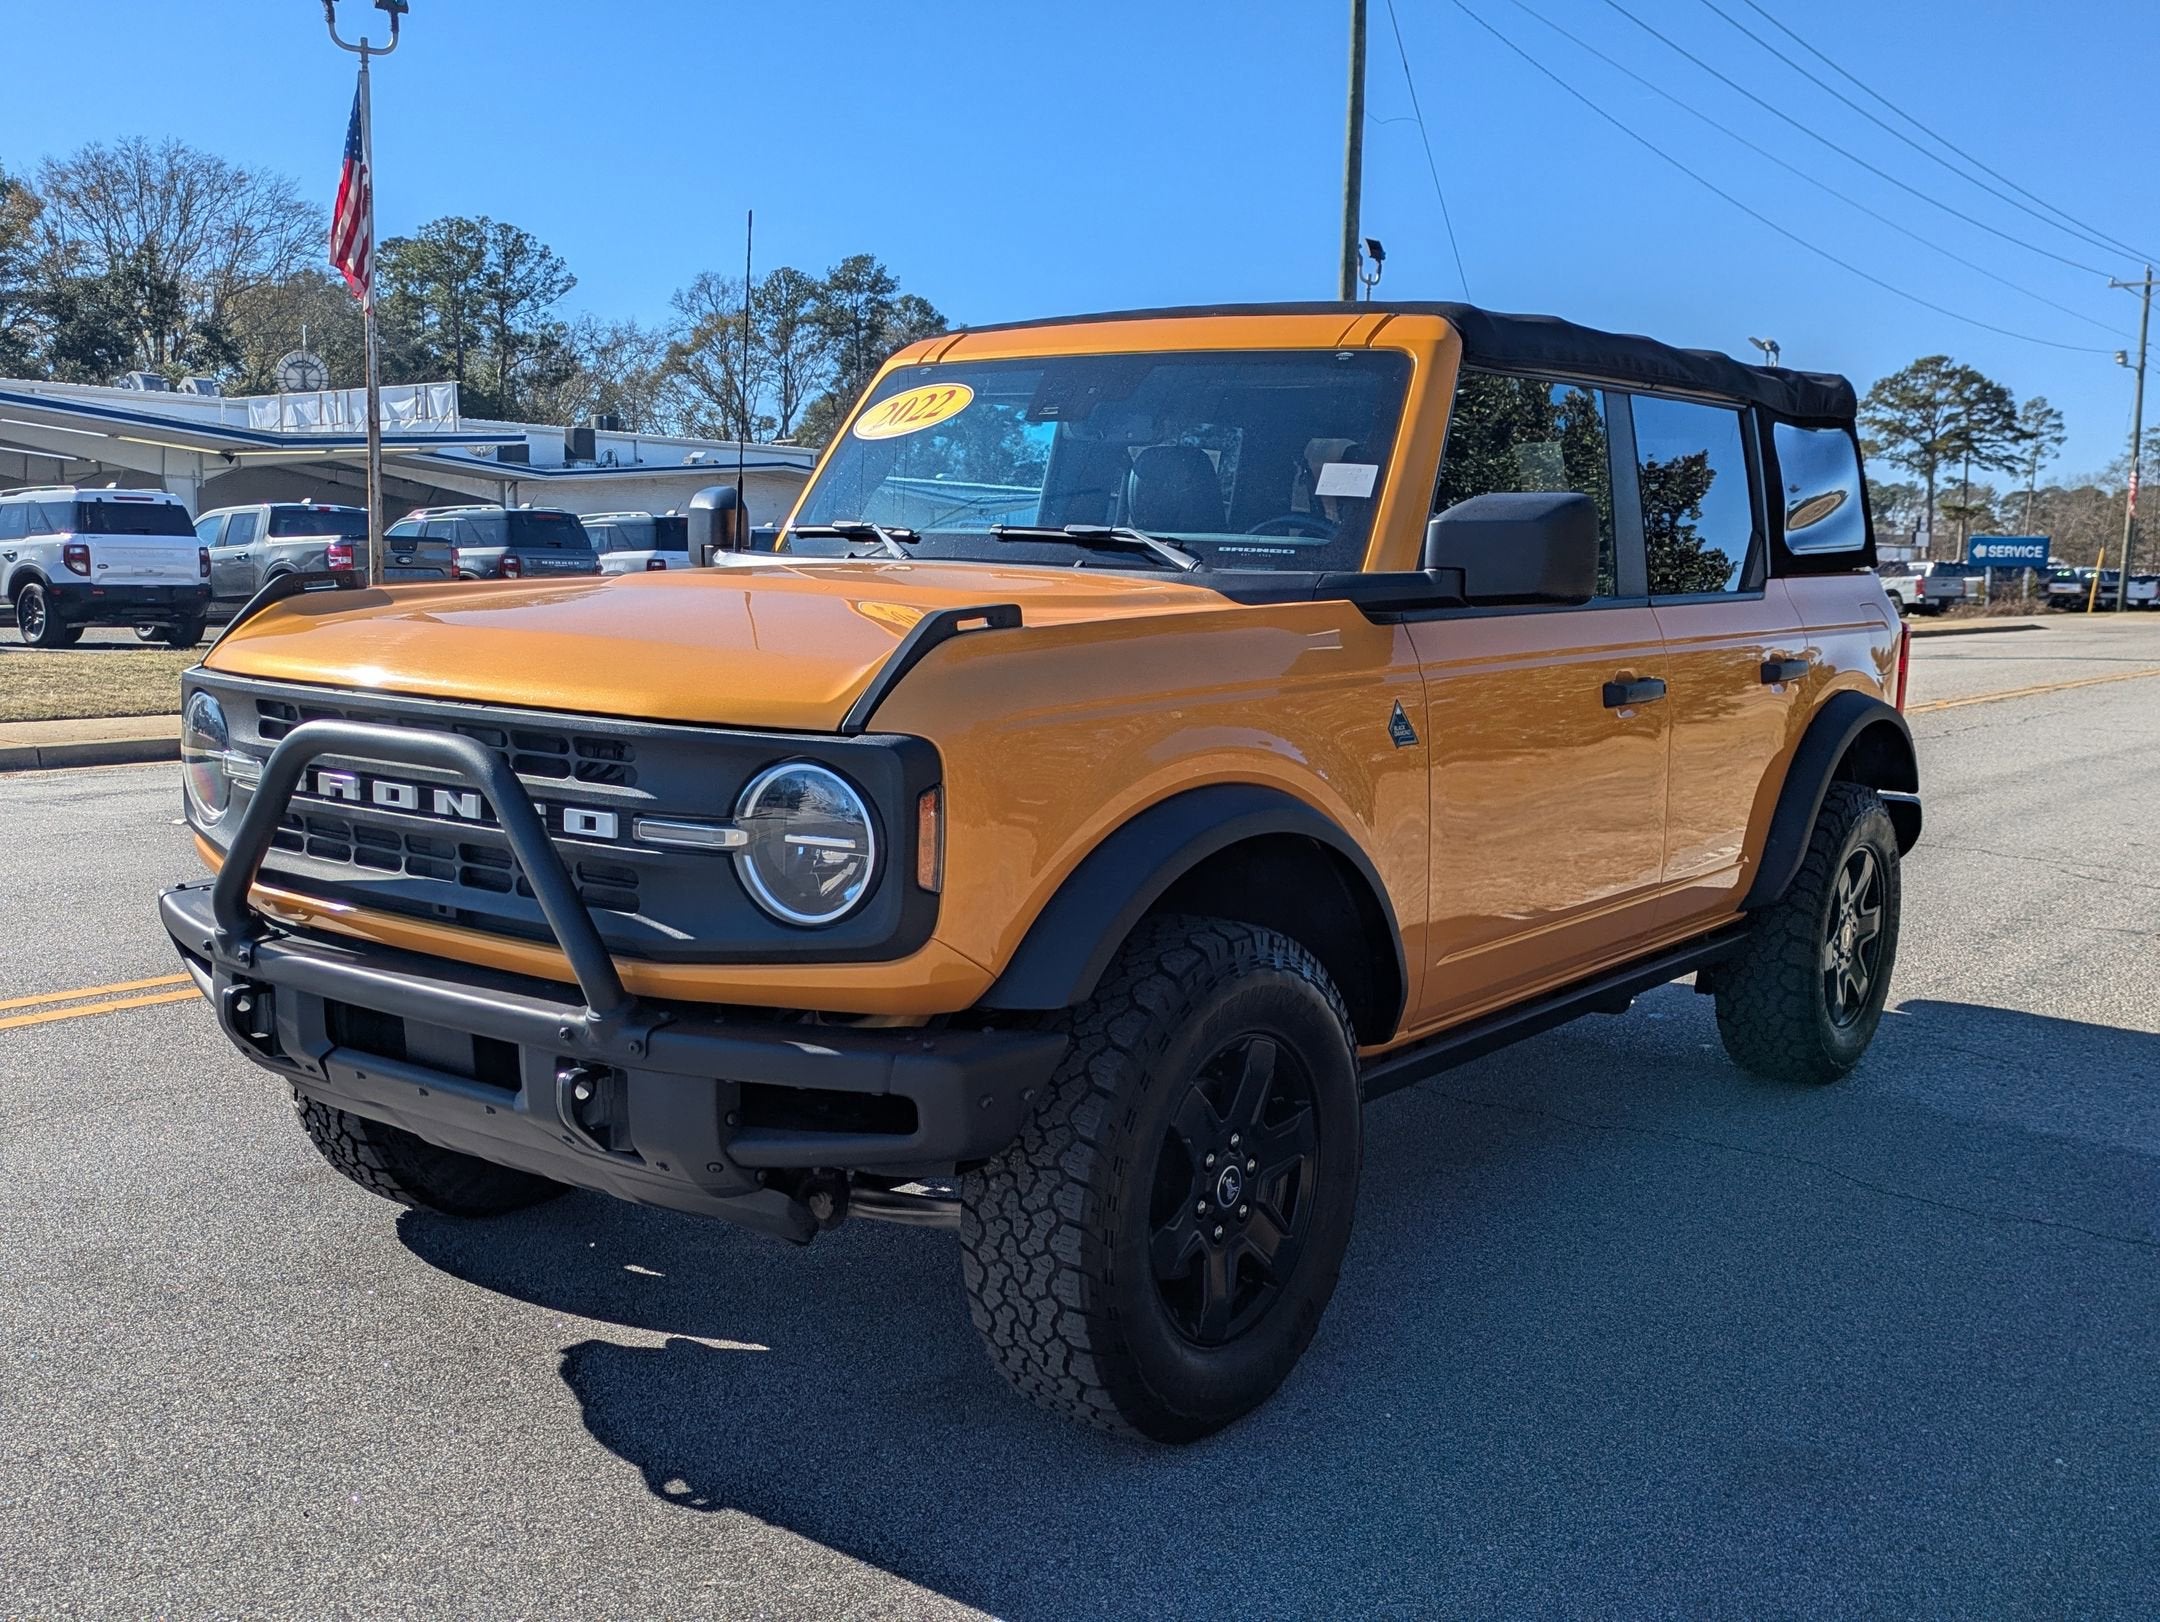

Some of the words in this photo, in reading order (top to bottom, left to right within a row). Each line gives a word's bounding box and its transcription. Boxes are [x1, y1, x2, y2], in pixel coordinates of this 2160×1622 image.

[868, 390, 957, 432] 2022
[1988, 545, 2044, 559] SERVICE
[295, 771, 619, 839] RONO
